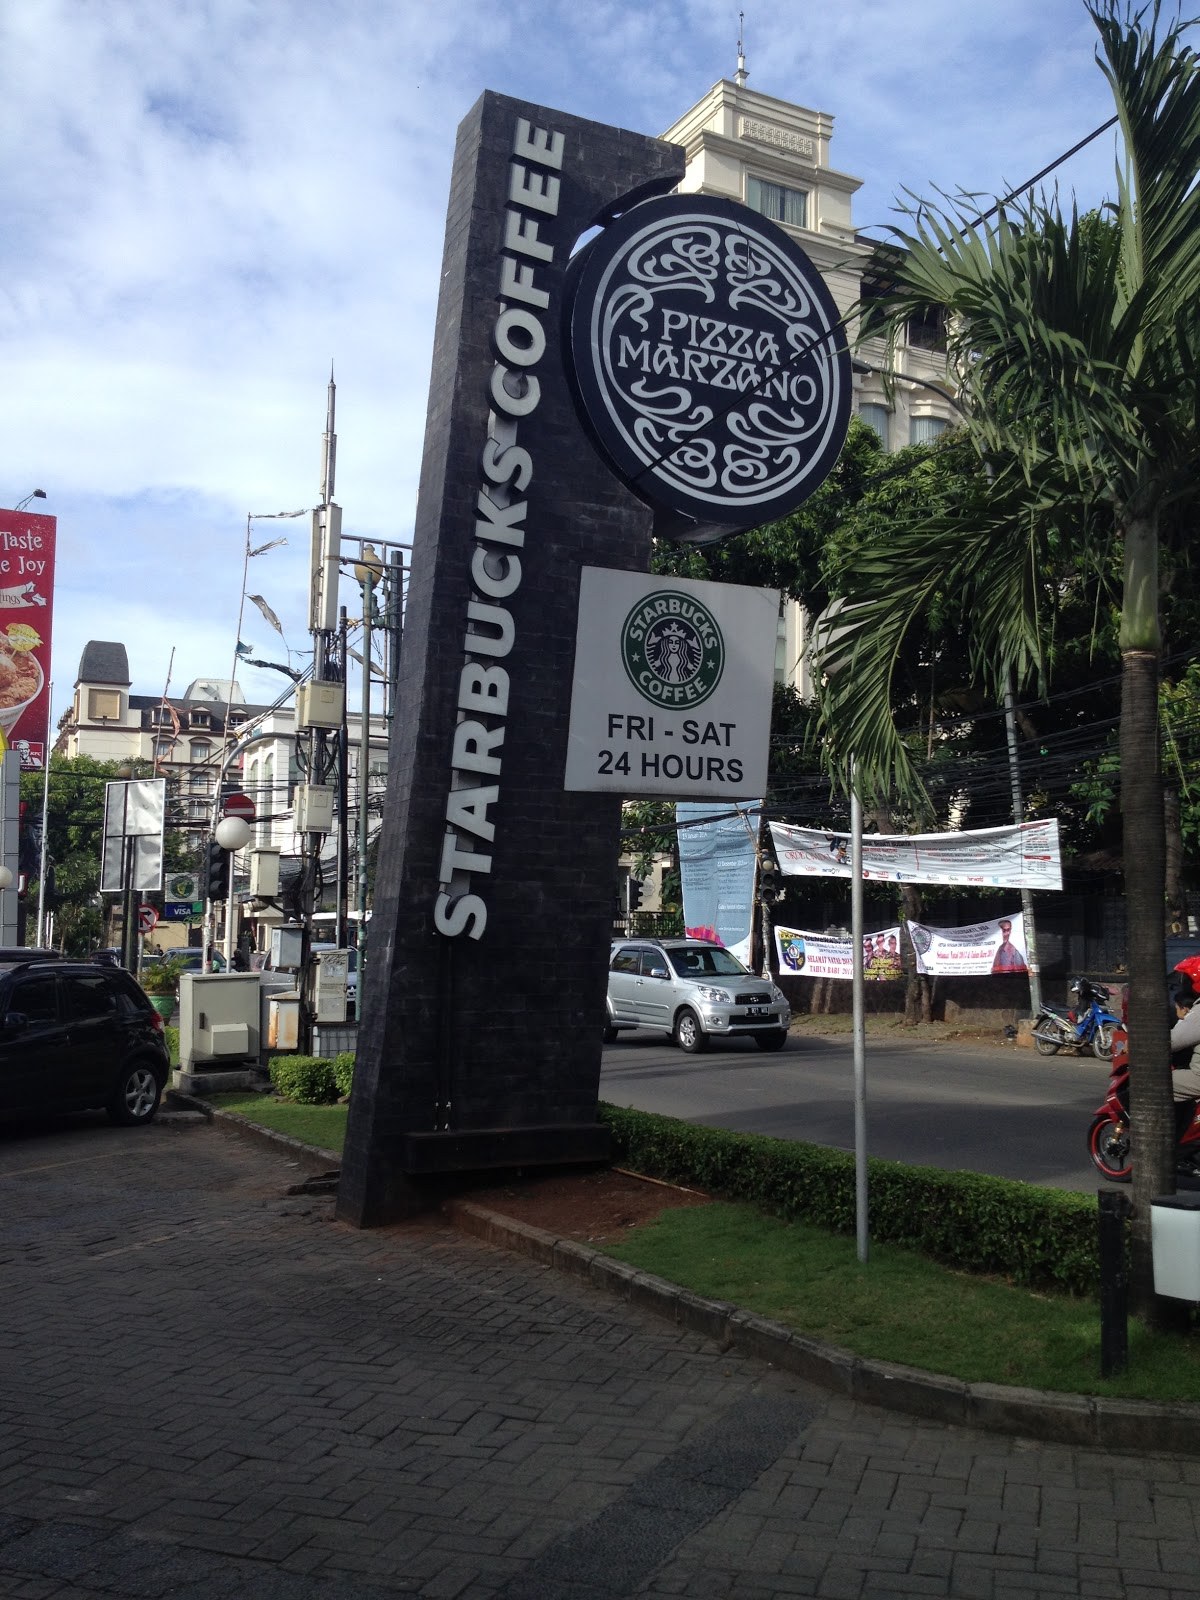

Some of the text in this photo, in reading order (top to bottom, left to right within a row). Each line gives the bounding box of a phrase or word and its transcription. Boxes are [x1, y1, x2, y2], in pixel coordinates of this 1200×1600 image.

[660, 307, 781, 367] PIZZA
[617, 334, 817, 406] MARZANO
[0, 528, 43, 552] Taste
[433, 116, 566, 942] STARBUCKS COFFEE
[18, 555, 46, 576] Joy
[629, 598, 718, 650] STARBUCKS
[638, 670, 707, 702] COFFEE
[608, 713, 654, 741] FRI
[682, 719, 737, 747] SAT
[597, 750, 744, 783] 24 HOURS
